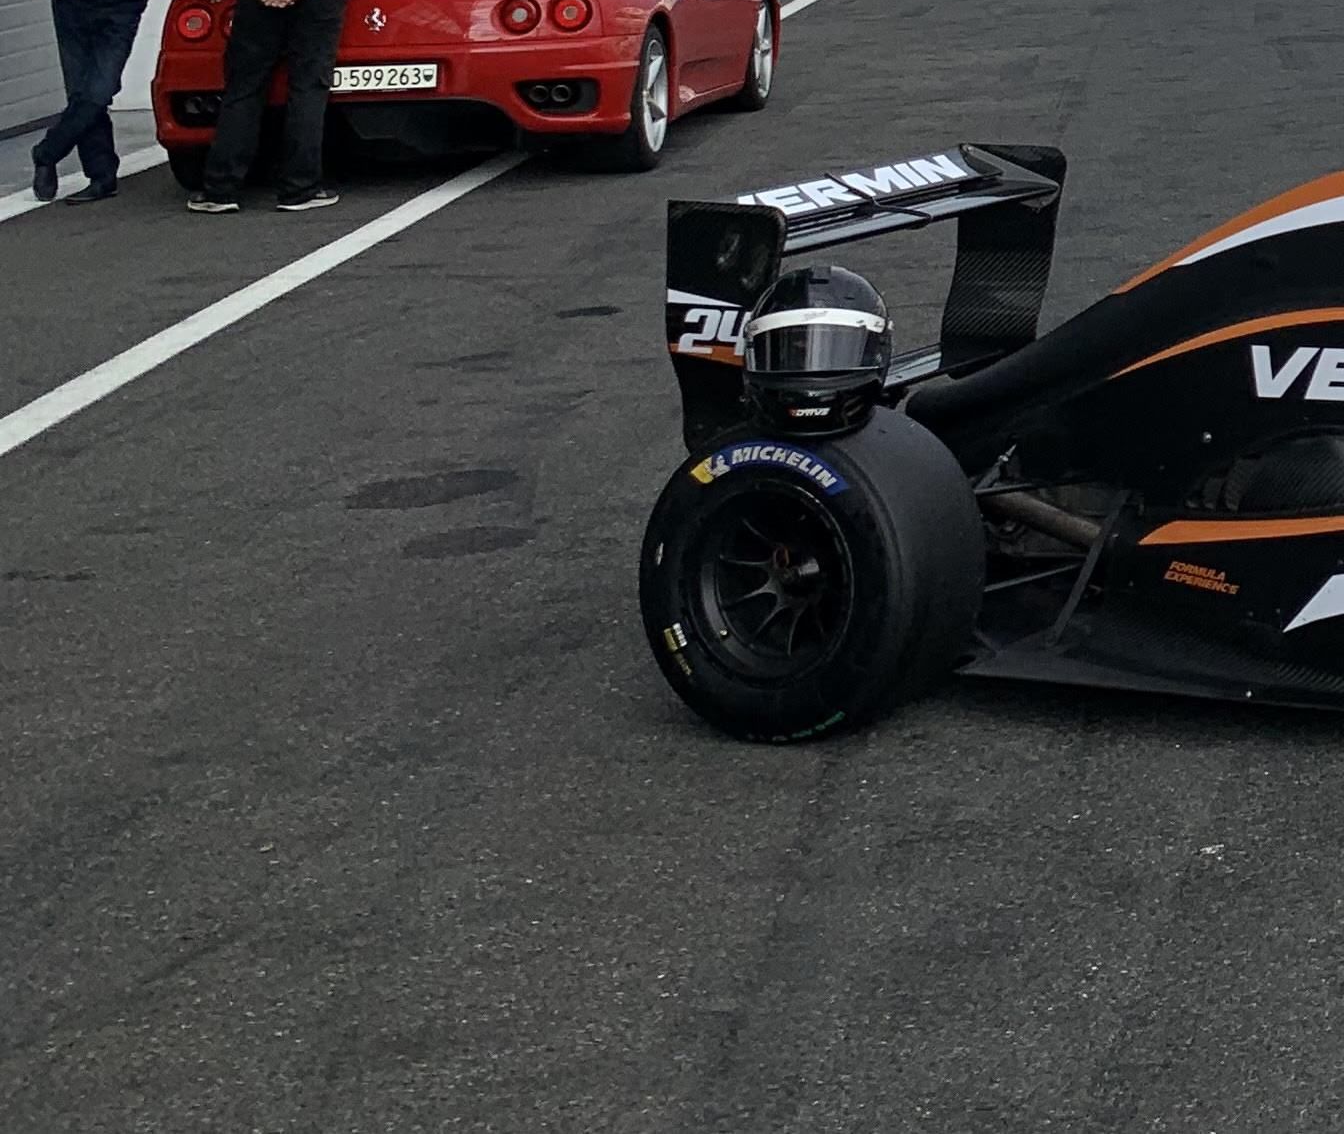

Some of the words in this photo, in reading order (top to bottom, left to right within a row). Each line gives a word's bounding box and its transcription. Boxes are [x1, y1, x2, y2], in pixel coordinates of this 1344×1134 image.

[737, 154, 968, 216] ERMIN
[678, 307, 752, 355] 24
[732, 445, 838, 489] MICHELIN
[1163, 570, 1240, 594] EXPERIENCE
[1169, 561, 1226, 582] FORMULA
